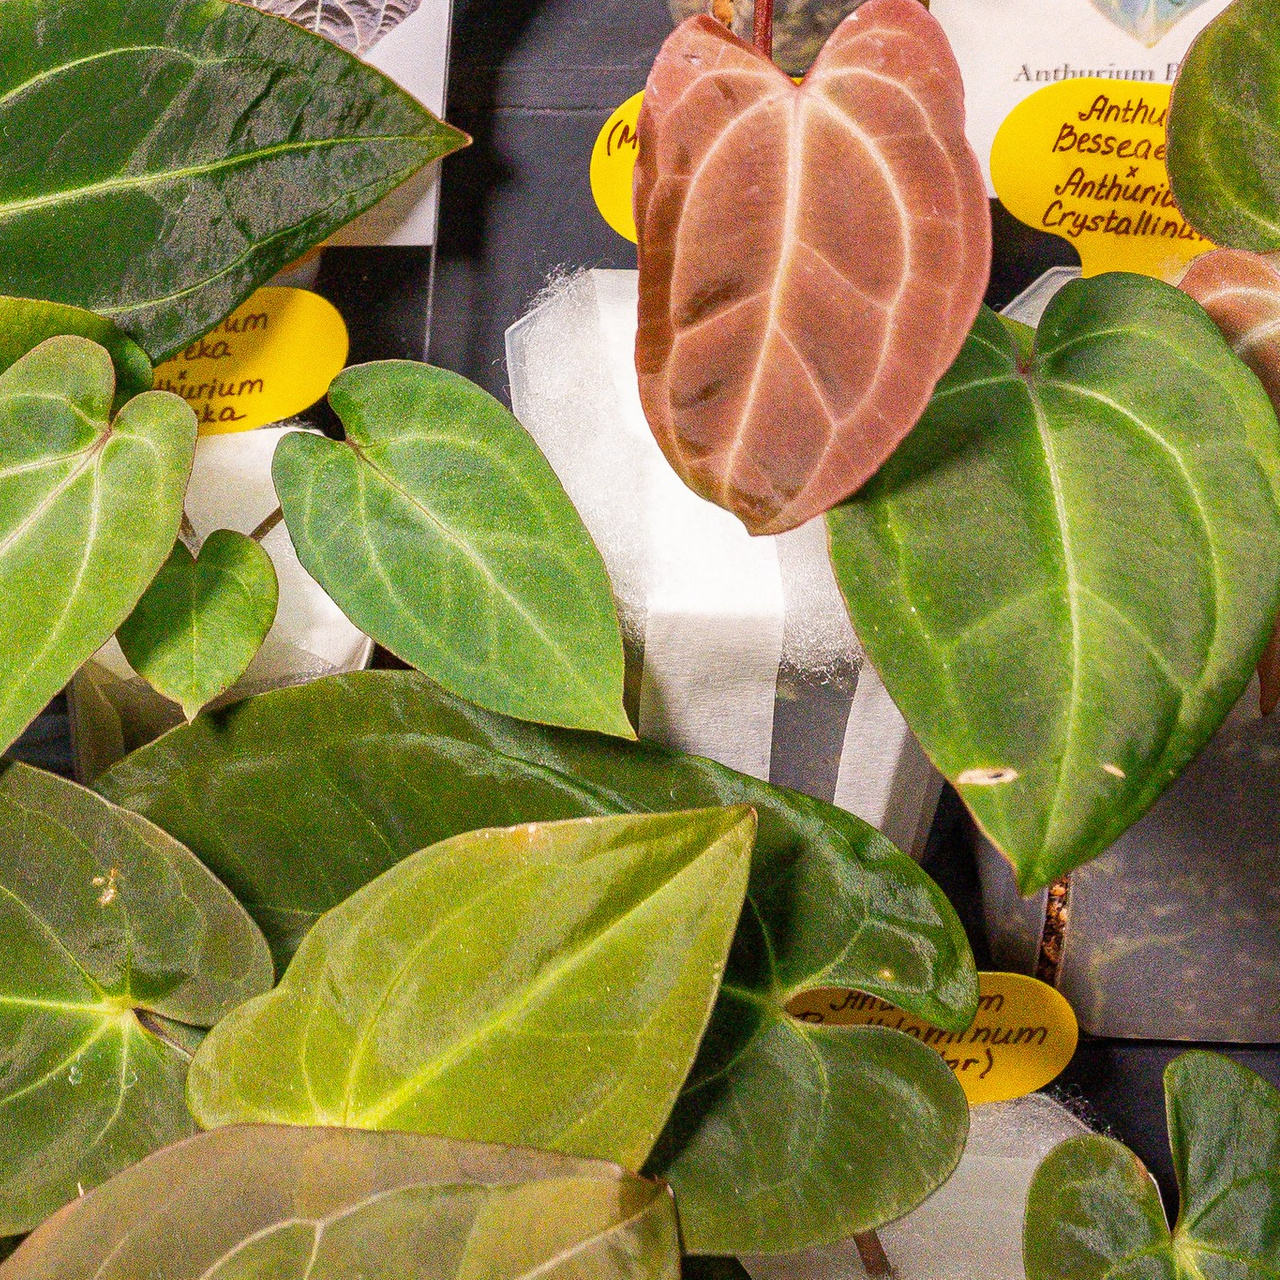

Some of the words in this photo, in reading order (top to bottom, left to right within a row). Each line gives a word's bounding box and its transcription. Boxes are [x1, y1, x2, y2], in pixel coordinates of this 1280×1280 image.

[1013, 63, 1156, 82] Anthurium
[1051, 122, 1167, 161] Besseae
[1041, 199, 1202, 239] Crystallinu
